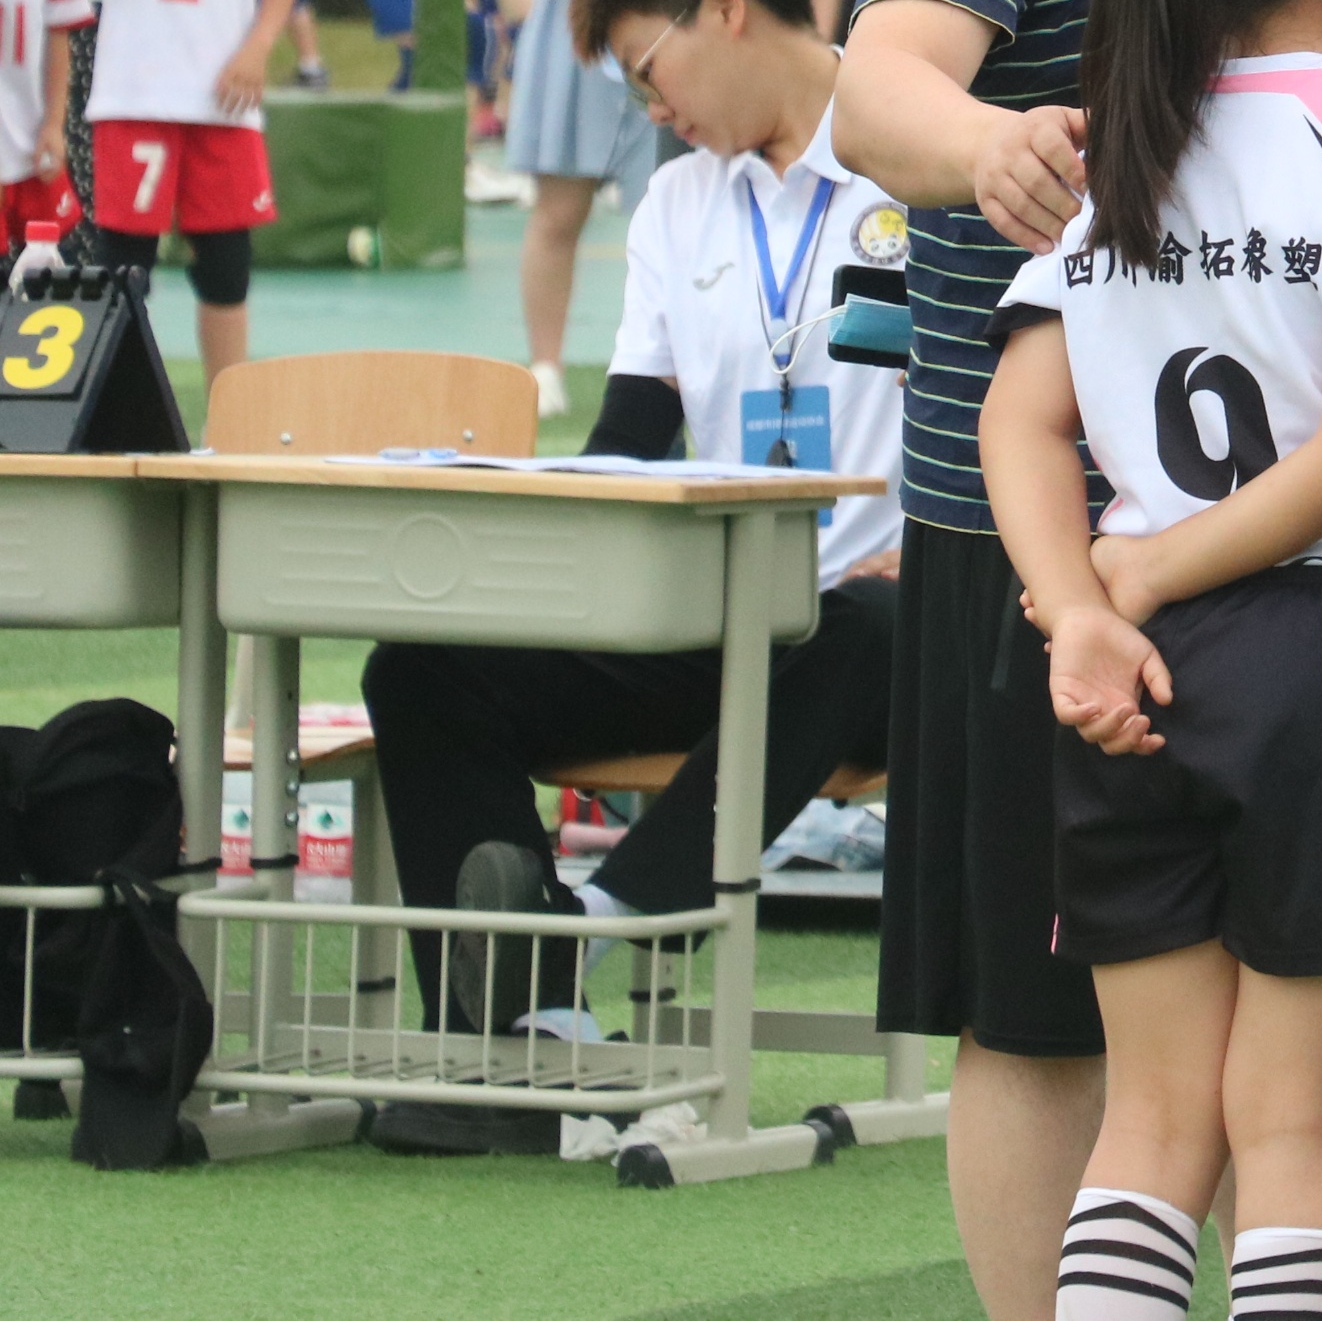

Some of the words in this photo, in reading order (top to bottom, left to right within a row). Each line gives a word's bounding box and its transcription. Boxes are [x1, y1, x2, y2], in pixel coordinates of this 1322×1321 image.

[132, 142, 168, 215] 7
[3, 305, 84, 389] 3
[1155, 347, 1278, 501] 9
